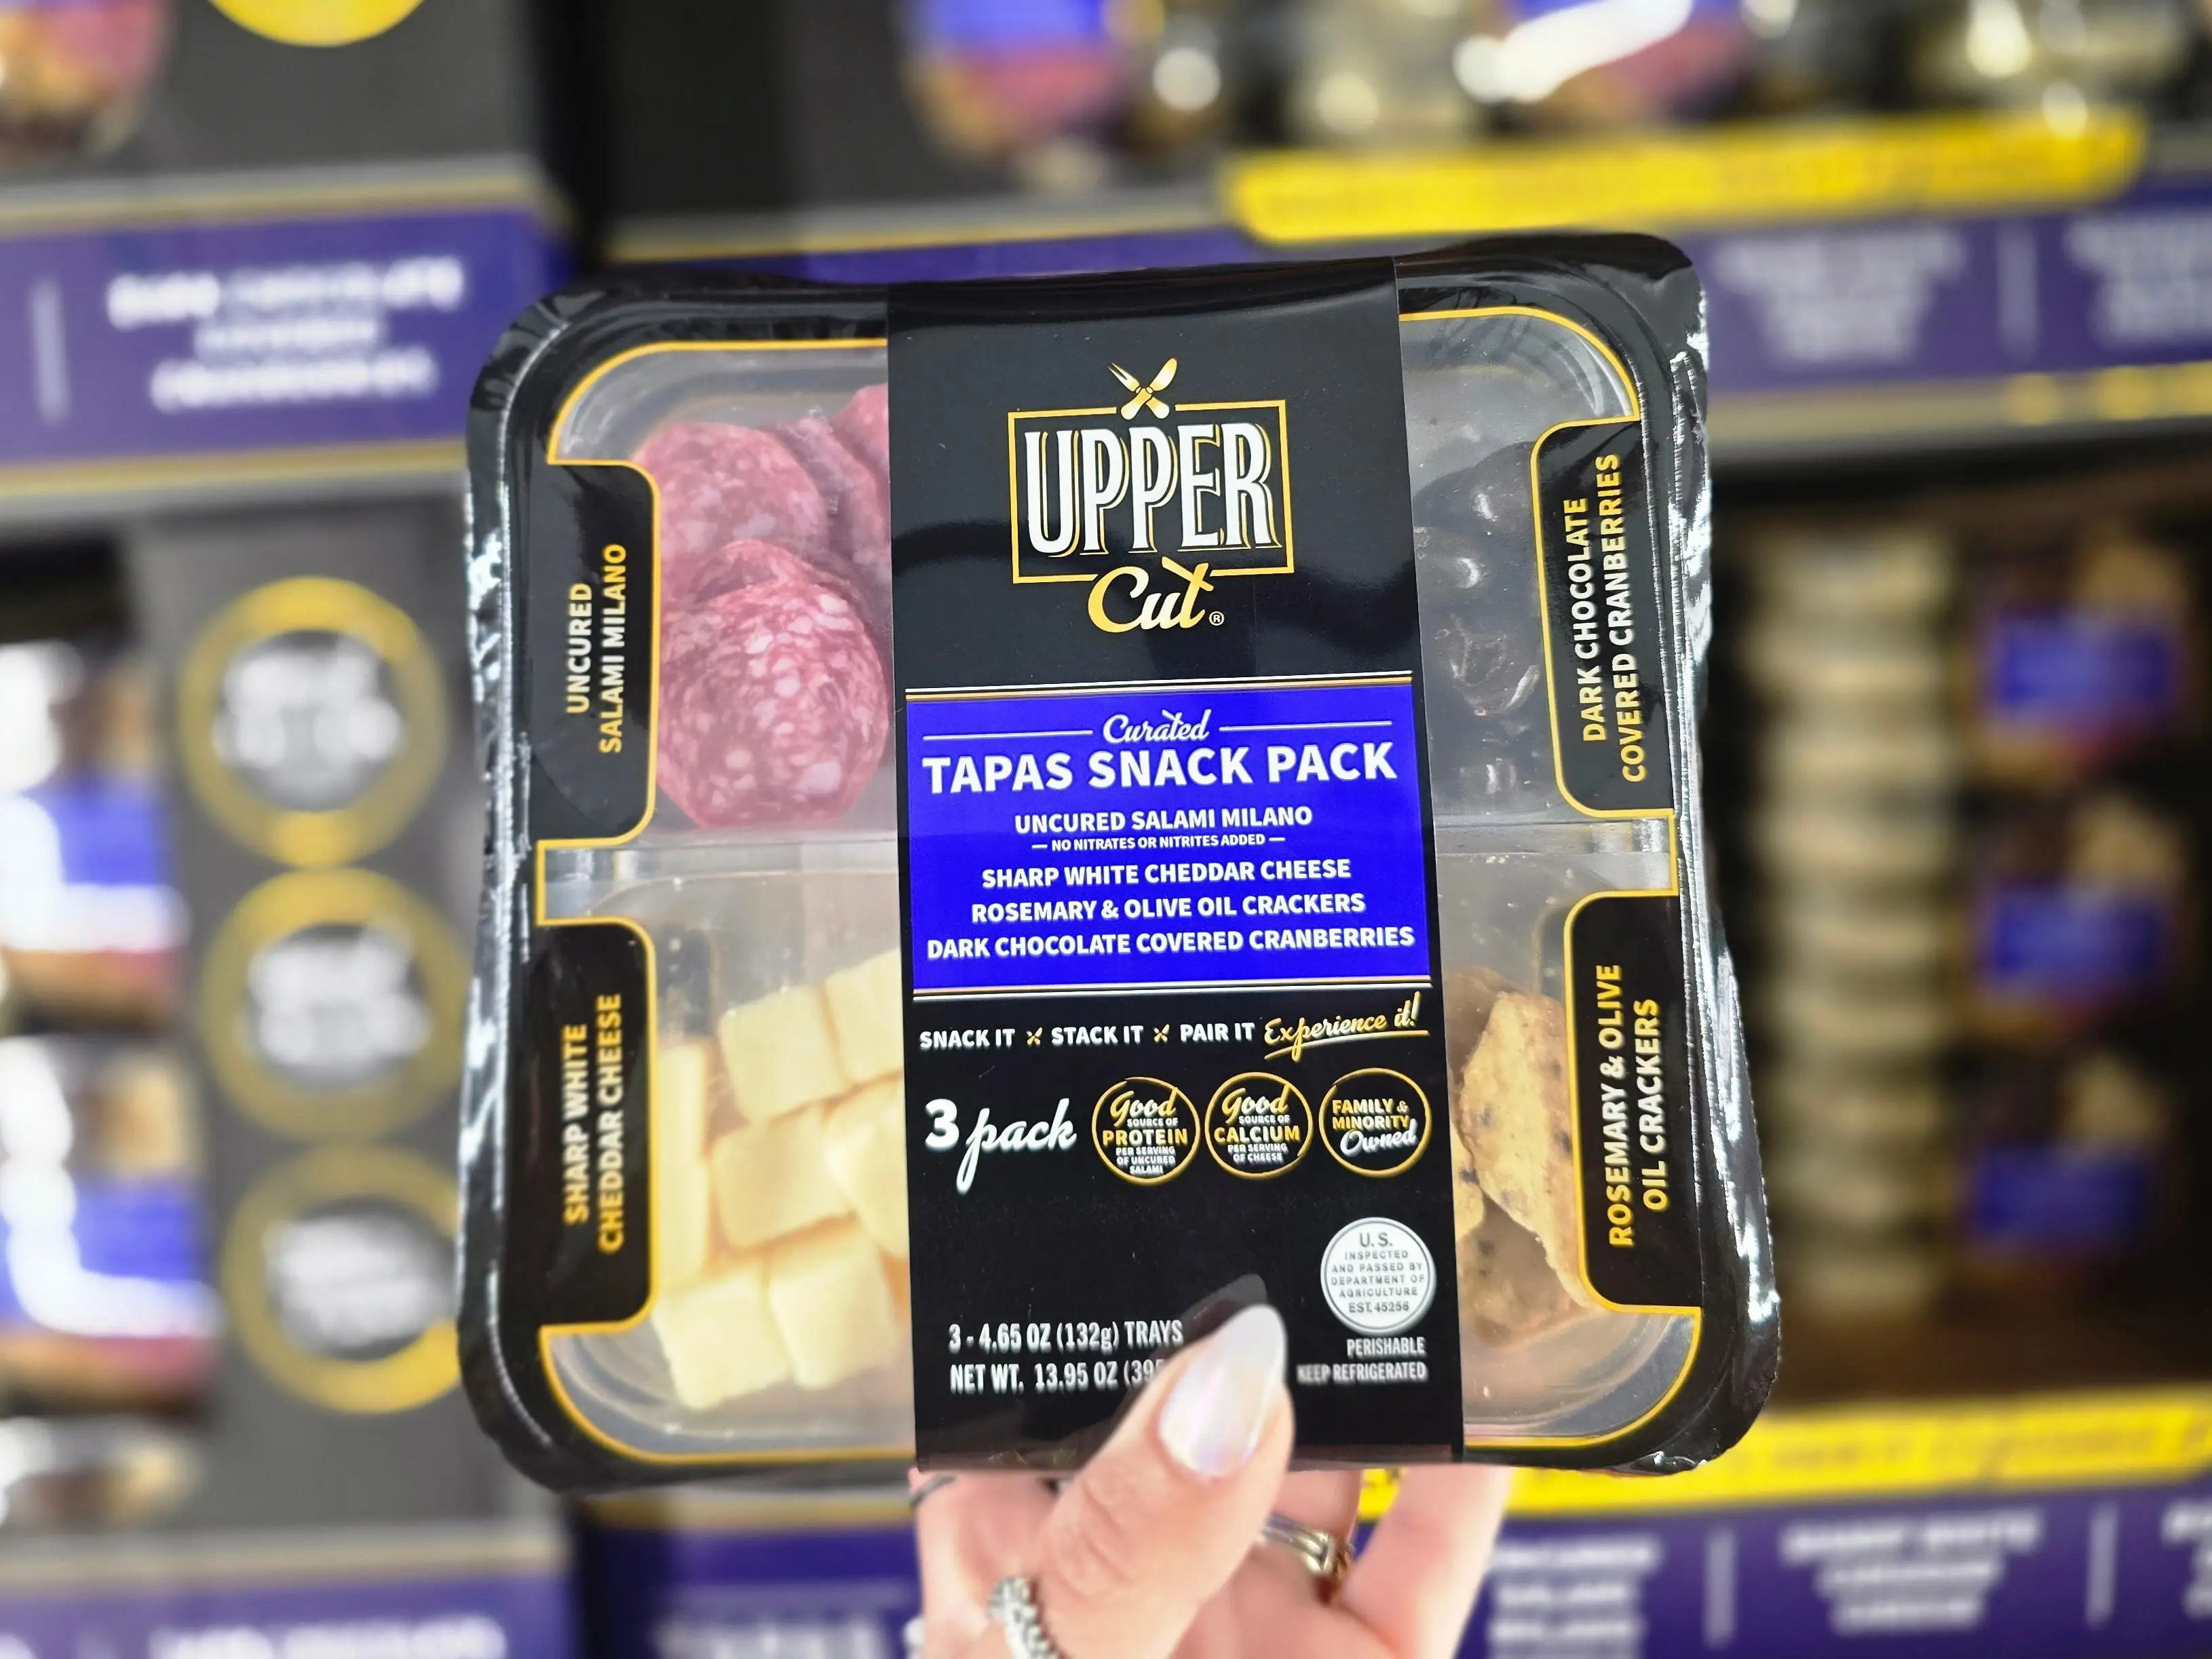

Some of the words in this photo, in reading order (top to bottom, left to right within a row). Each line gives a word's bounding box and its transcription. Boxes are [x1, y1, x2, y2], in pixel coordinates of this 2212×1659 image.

[1025, 421, 1282, 558] UPPER
[1595, 454, 1634, 646] CRANBERRIES
[1563, 497, 1600, 659] CHOCOLATE
[601, 544, 627, 648] MILANO
[566, 583, 592, 714] UNCURED
[598, 655, 625, 754] SALAMI
[1577, 666, 1607, 742] DARK
[1611, 654, 1647, 782] COVERED
[1103, 709, 1211, 744] Curated
[922, 752, 1073, 794] TAPAS
[1088, 746, 1253, 788] SNACK
[1267, 742, 1398, 783] PACK
[1014, 812, 1126, 834] UNCURED
[1131, 809, 1216, 830] SALAMI
[1221, 805, 1312, 828] MILANO
[1052, 839, 1071, 852] NO
[1073, 837, 1136, 851] NITRATES
[1138, 836, 1158, 849] OR
[1160, 835, 1219, 848] NITRITES
[1221, 833, 1265, 846] ADDED
[982, 866, 1059, 888] SHARP
[1064, 864, 1139, 885] WHITE
[1144, 861, 1255, 883] CHEDDAR
[1260, 858, 1352, 880] CHEESE
[972, 900, 1097, 923] ROSEMARY
[1101, 899, 1119, 919] &
[1124, 897, 1192, 918] OLIVE
[1197, 896, 1237, 917] OIL
[1242, 892, 1366, 915] CRACKERS
[927, 937, 991, 959] DARK
[995, 934, 1131, 957] CHOCOLATE
[1136, 930, 1244, 953] COVERED
[1248, 926, 1415, 949] CRANBERRIES
[1596, 964, 1625, 1050] OLIVE
[919, 1029, 991, 1050] SNACK
[995, 1028, 1016, 1048] IT
[1050, 1025, 1119, 1046] STACK
[1124, 1025, 1144, 1045] IT
[1180, 1023, 1231, 1043] PAIR
[1234, 1022, 1255, 1042] IT
[1264, 1014, 1388, 1063] Experience
[1394, 991, 1421, 1028] it!
[596, 993, 623, 1107] CHEESE
[561, 1024, 588, 1120] WHITE
[1600, 1056, 1626, 1080] &
[1633, 998, 1667, 1154] CRACKERS
[1109, 1086, 1179, 1127] Good
[1221, 1084, 1291, 1126] Good
[1238, 1115, 1274, 1126] SOURCE
[1277, 1114, 1292, 1124] OF
[1331, 1098, 1394, 1115] FAMILY
[1396, 1100, 1409, 1113] &
[1102, 1128, 1188, 1147] PROTEIN
[1126, 1118, 1161, 1128] SOURCE
[1164, 1117, 1179, 1127] OF
[1213, 1125, 1301, 1145] CALCIUM
[1332, 1115, 1411, 1131] MINORITY
[1340, 1118, 1419, 1158] Owned
[924, 1098, 960, 1151] 3
[955, 1097, 1078, 1196] pack
[1115, 1147, 1134, 1157] PER
[1136, 1145, 1177, 1156] SERVING
[1116, 1156, 1129, 1166] OF
[1130, 1155, 1177, 1166] UNCURED
[1227, 1144, 1246, 1155] PER
[1247, 1143, 1289, 1153] SERVING
[1232, 1153, 1246, 1164] OF
[1247, 1152, 1284, 1164] CHEESE
[563, 1123, 589, 1225] SHARP
[597, 1109, 624, 1253] CHEDDAR
[1129, 1164, 1164, 1175] SALAMI
[1602, 1084, 1633, 1247] ROSEMARY
[1641, 1160, 1669, 1211] OIL
[1331, 1264, 1354, 1274] AND
[1359, 1262, 1405, 1272] PASSED
[1409, 1261, 1423, 1272] BY
[1344, 1249, 1409, 1261] INSPECTED
[1331, 1274, 1406, 1286] DEPARTMENT
[1410, 1274, 1426, 1284] OF
[1339, 1286, 1418, 1298] AGRICULTURE
[949, 1323, 961, 1354] 3
[978, 1322, 1023, 1354] 4.65
[1026, 1322, 1052, 1354] OZ
[1056, 1320, 1120, 1356] (132g)
[1124, 1319, 1184, 1350] TRAYS
[1346, 1336, 1426, 1358] PERISHABLE
[950, 1363, 986, 1394] NET
[990, 1363, 1025, 1394] WT.
[1033, 1362, 1089, 1394] 13.95
[1093, 1360, 1119, 1391] OZ
[1296, 1363, 1331, 1384] KEEP
[1332, 1361, 1429, 1383] REFRIGERATED
